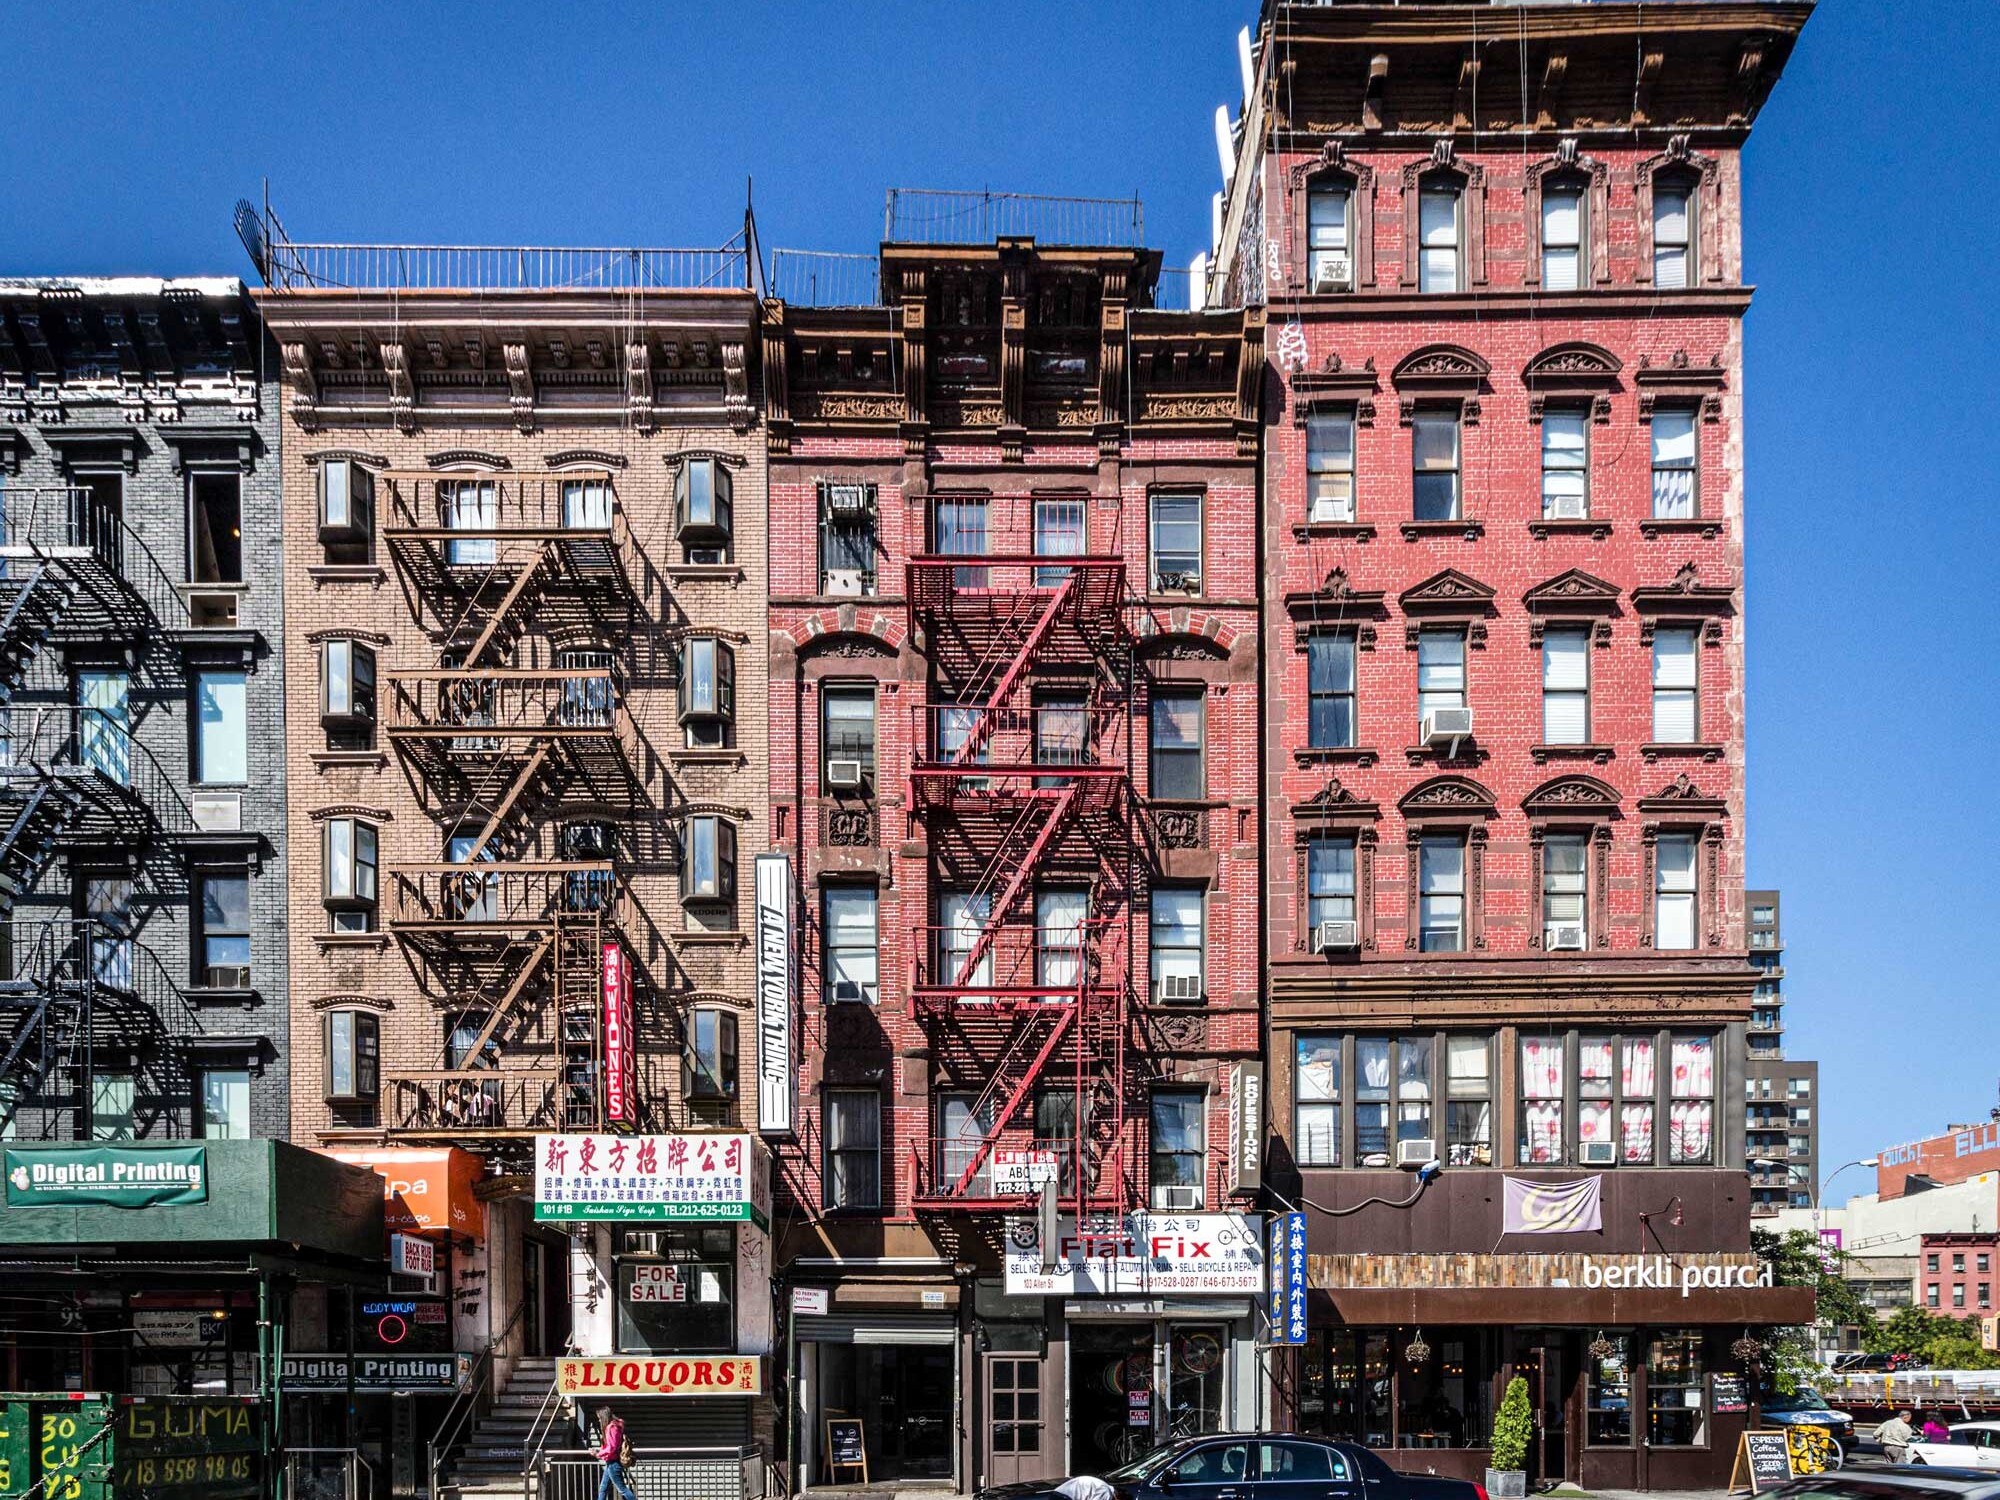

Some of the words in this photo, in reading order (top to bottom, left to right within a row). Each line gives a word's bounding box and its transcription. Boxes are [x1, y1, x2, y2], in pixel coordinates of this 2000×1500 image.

[760, 923, 786, 976] NEW
[760, 970, 787, 1028] YORK
[621, 951, 636, 1121] LIQUORS
[761, 1023, 787, 1084] THING
[1243, 1075, 1258, 1170] PROFESSIONAL
[1231, 1099, 1239, 1187] COMPUTER
[544, 1137, 742, 1176] 新東方招牌公司
[32, 1163, 105, 1184] Digital
[112, 1161, 201, 1182] Printing
[543, 1204, 556, 1214] 101
[616, 1204, 635, 1217] Sign
[405, 1241, 420, 1257] BACK
[421, 1244, 432, 1259] RUB
[1061, 1237, 1136, 1259] Flat
[1151, 1236, 1212, 1259] Fix
[405, 1255, 420, 1271] FOOT
[421, 1257, 432, 1273] RUB
[637, 1266, 676, 1282] FOR
[1010, 1263, 1027, 1274] SELL
[1098, 1263, 1118, 1273] WELD
[1120, 1263, 1156, 1273] ALUMINUM
[1157, 1263, 1173, 1273] RIMS
[1179, 1262, 1196, 1273] SELL
[1197, 1262, 1226, 1273] BICYCLE
[1227, 1262, 1232, 1273] &
[1233, 1262, 1259, 1272] REPAIR
[1583, 1255, 1672, 1289] berkli
[1681, 1264, 1755, 1298] parc
[1033, 1279, 1047, 1289] Allen
[1048, 1279, 1054, 1289] St
[1290, 1216, 1306, 1339] 承接室內外裝修
[631, 1284, 685, 1300] SALE
[284, 1360, 349, 1378] Digita
[364, 1360, 452, 1378] Printing
[580, 1362, 735, 1391] LIQUORS
[42, 1415, 76, 1442] 30
[128, 1405, 251, 1438] GUMA
[1750, 1436, 1784, 1444] ESPRESSO
[41, 1443, 80, 1470] CU
[231, 1455, 250, 1478] 05
[1752, 1450, 1786, 1460] Lemonade
